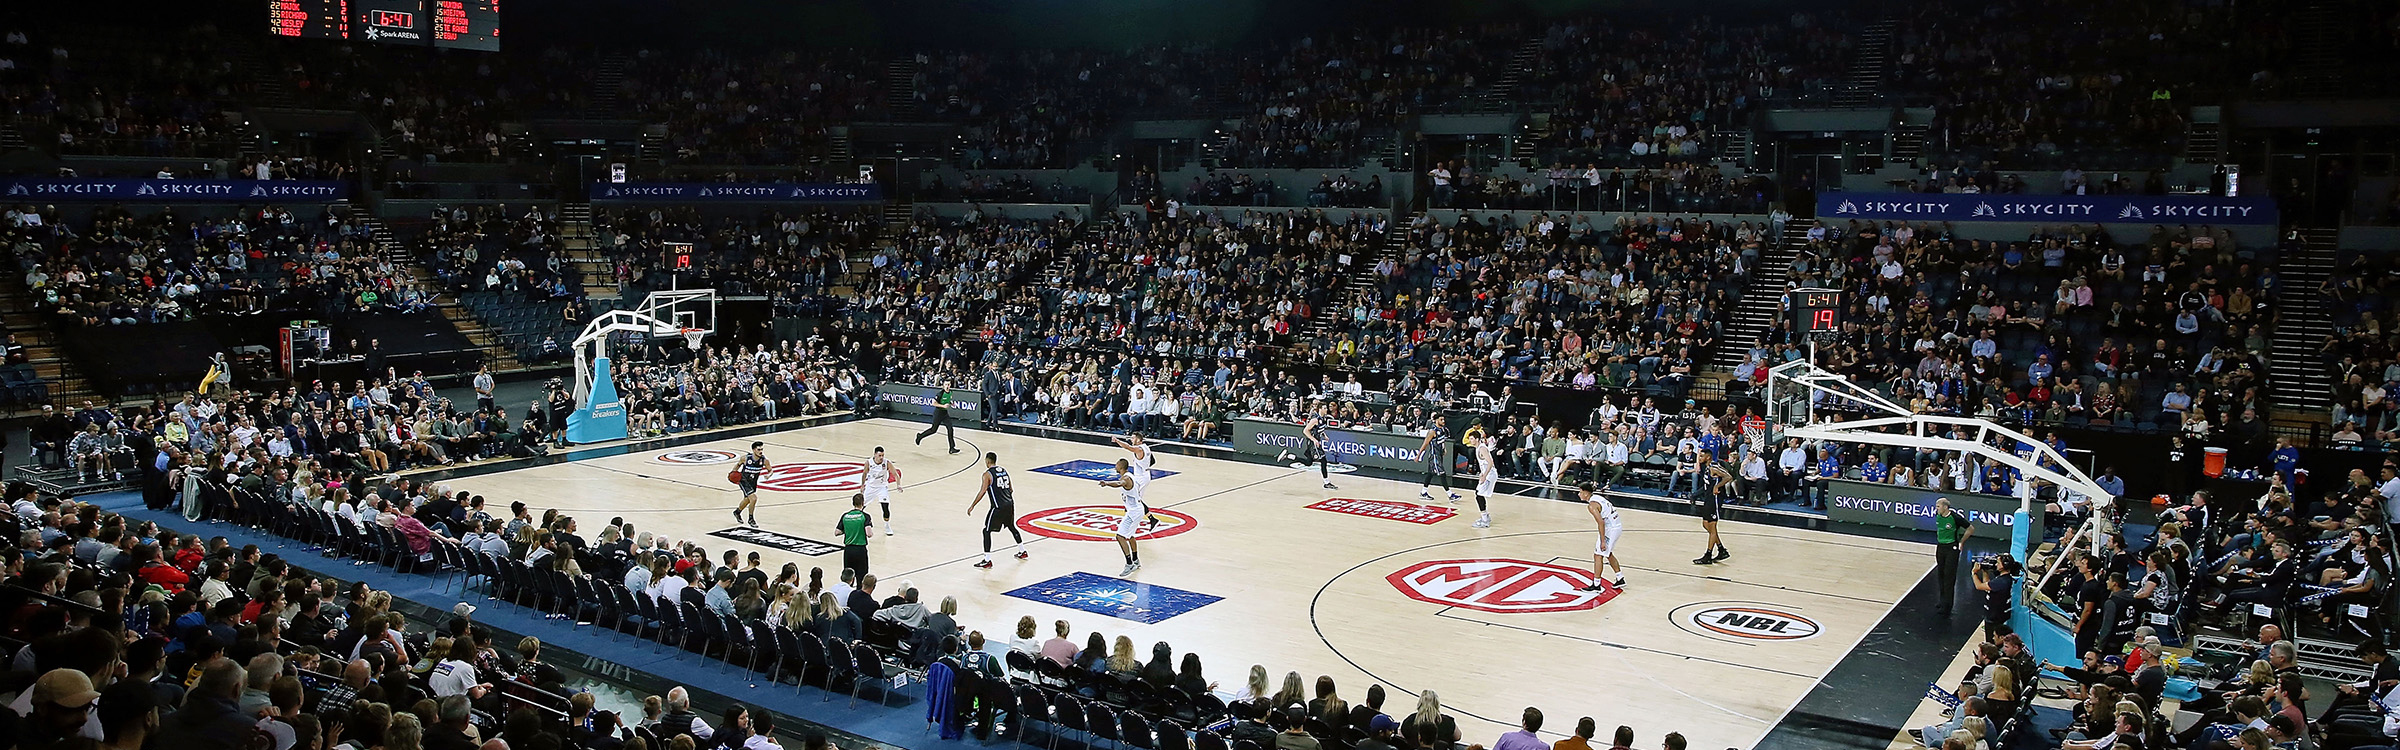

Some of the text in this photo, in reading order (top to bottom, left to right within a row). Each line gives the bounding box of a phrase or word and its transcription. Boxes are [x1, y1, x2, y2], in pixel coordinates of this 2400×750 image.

[270, 2, 280, 10] 22
[270, 10, 280, 18] 35
[380, 12, 412, 28] 6:41
[36, 184, 116, 193] SKYCITY
[162, 184, 232, 194] SKYCITY
[272, 186, 336, 195] SKYCITY
[810, 188, 868, 196] SKYCITY
[1865, 202, 1950, 214] SKYCITY
[2003, 203, 2094, 214] SKYCITY
[2152, 205, 2252, 216] SKYCITY
[675, 245, 692, 254] 6:41
[677, 254, 690, 268] 19
[1808, 294, 1840, 306] 6:41
[1813, 310, 1834, 330] 19
[882, 392, 909, 404] SKYCITY
[962, 401, 977, 410] DAY
[592, 410, 620, 418] breakers
[1256, 433, 1304, 448] SKYCITY
[1321, 440, 1366, 456] EAKERS
[1370, 445, 1395, 458] FAN
[996, 476, 1010, 488] 42
[1326, 500, 1448, 519] CHEMIST
[1835, 496, 1892, 512] SKYCITY
[1969, 510, 2000, 525] FAN
[1415, 565, 1583, 607] MG
[1040, 590, 1152, 613] SKYCITY
[1717, 612, 1791, 634] NBL
